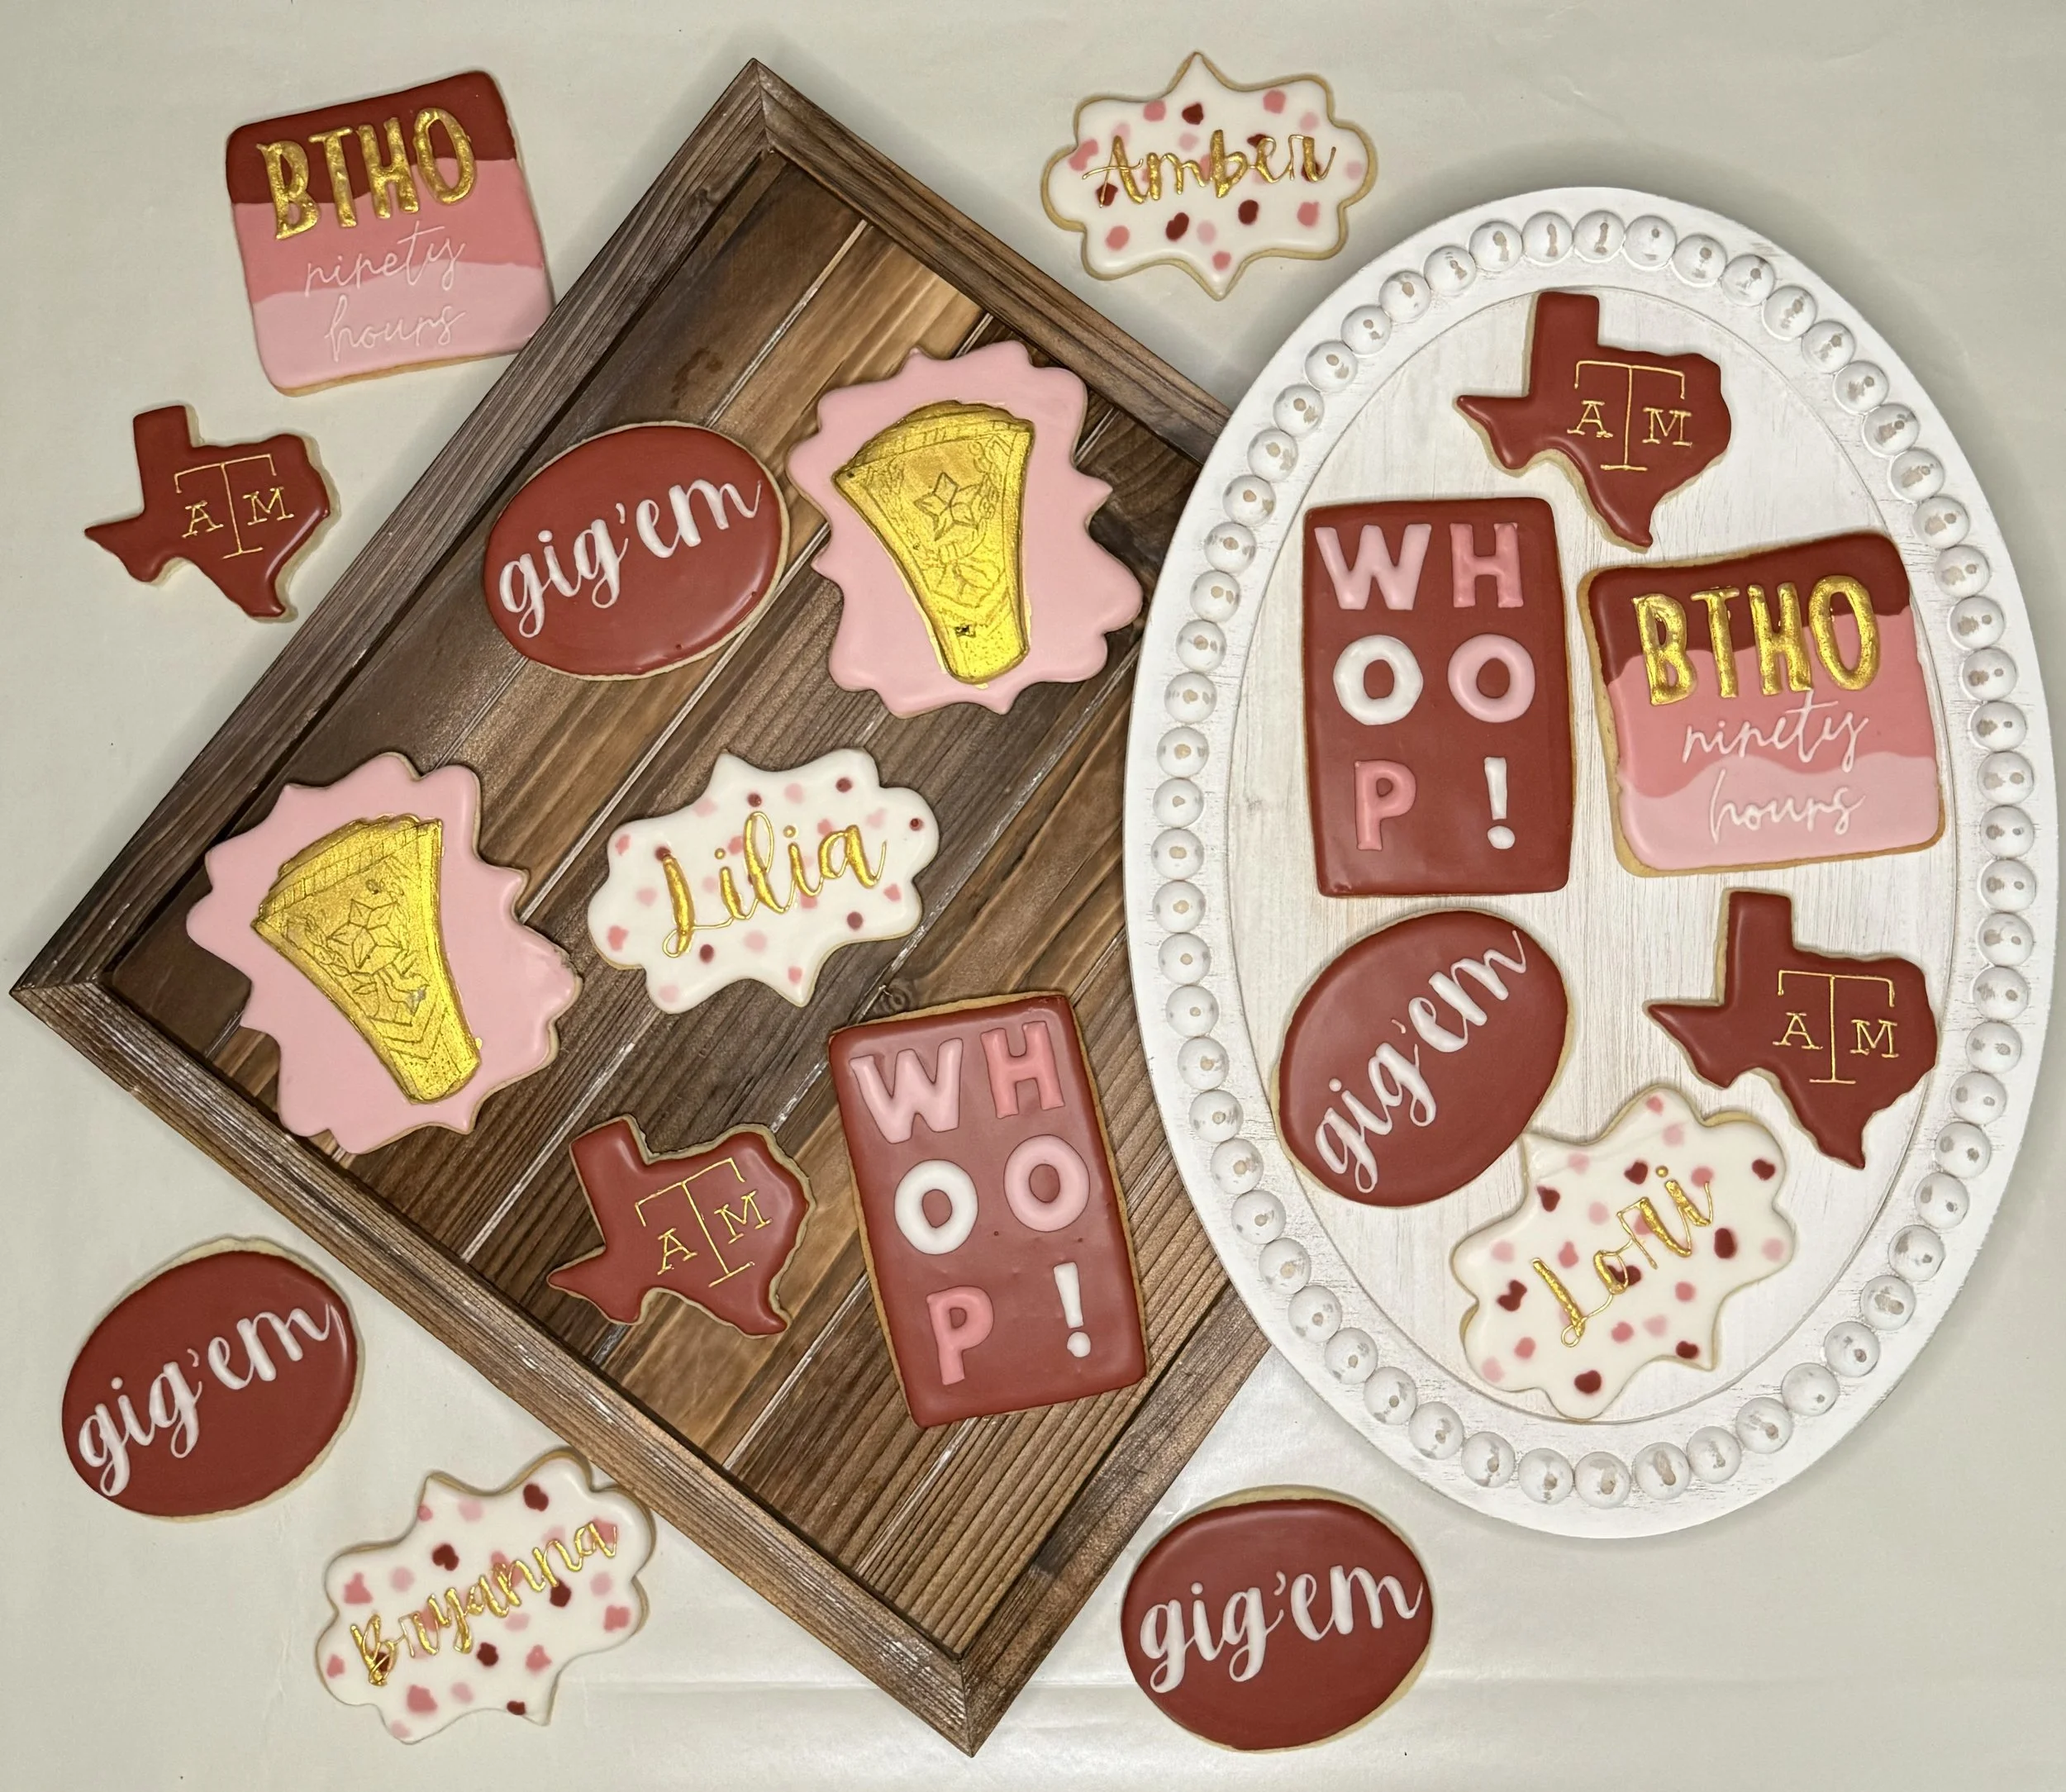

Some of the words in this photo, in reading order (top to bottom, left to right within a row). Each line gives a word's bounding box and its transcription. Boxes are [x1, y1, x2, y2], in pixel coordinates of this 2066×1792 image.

[257, 107, 476, 240] BTHO
[1082, 129, 1337, 208] Amber
[304, 220, 465, 297] ninety
[324, 294, 465, 363] hours
[1633, 573, 1881, 708] BTHO
[1682, 689, 1867, 772] ninety
[1710, 769, 1865, 842] hours
[659, 811, 885, 956] Lilia
[1531, 1165, 1714, 1348] Lori
[350, 1520, 618, 1686] Bryanna
